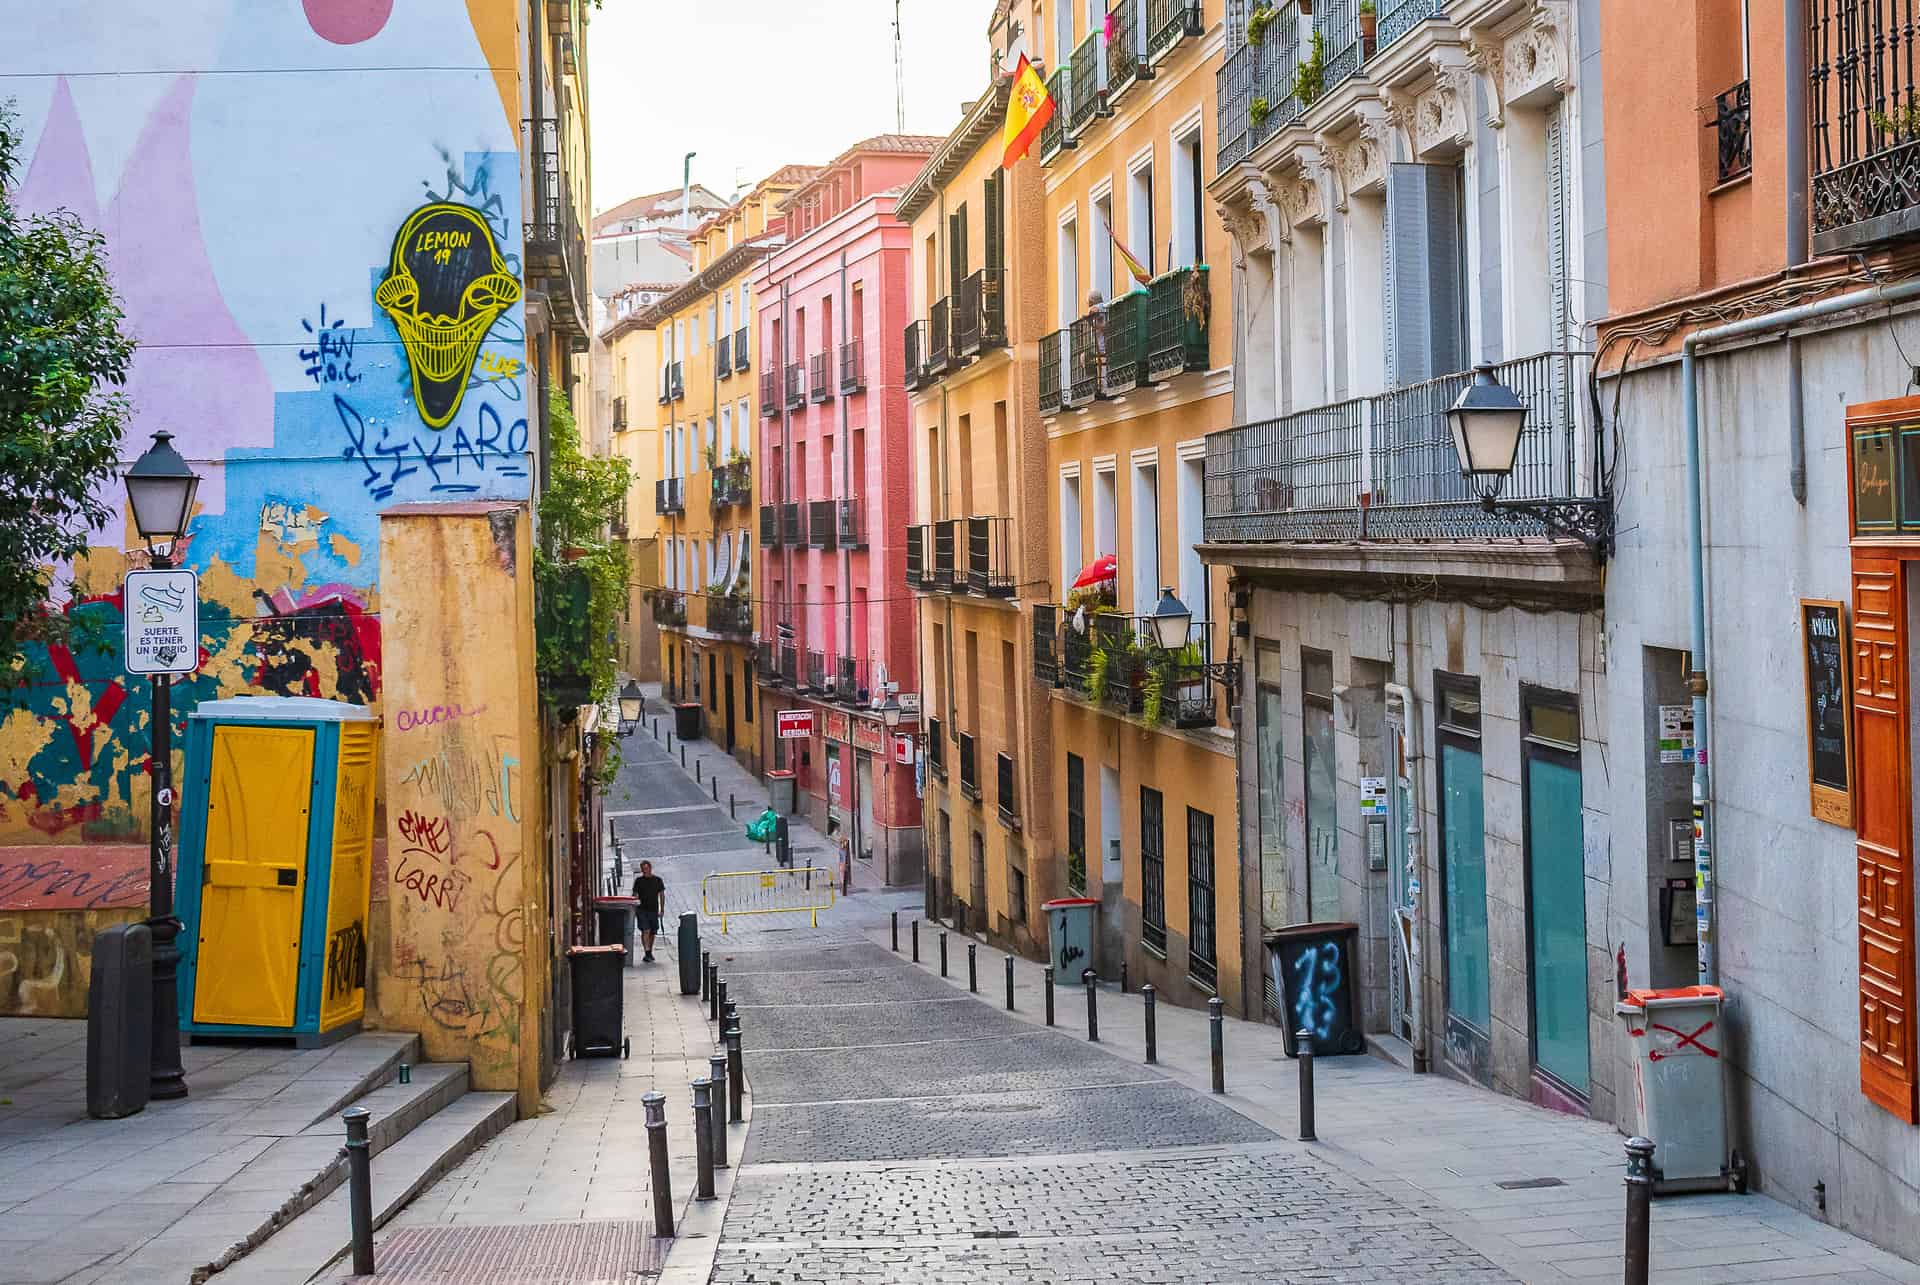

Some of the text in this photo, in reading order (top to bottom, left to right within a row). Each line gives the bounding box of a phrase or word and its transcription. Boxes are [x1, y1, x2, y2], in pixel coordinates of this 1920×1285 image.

[415, 231, 472, 252] LEMON
[434, 248, 452, 265] 19
[144, 627, 179, 636] SUERTE
[140, 636, 183, 646] ES TENER
[136, 647, 150, 655] UN
